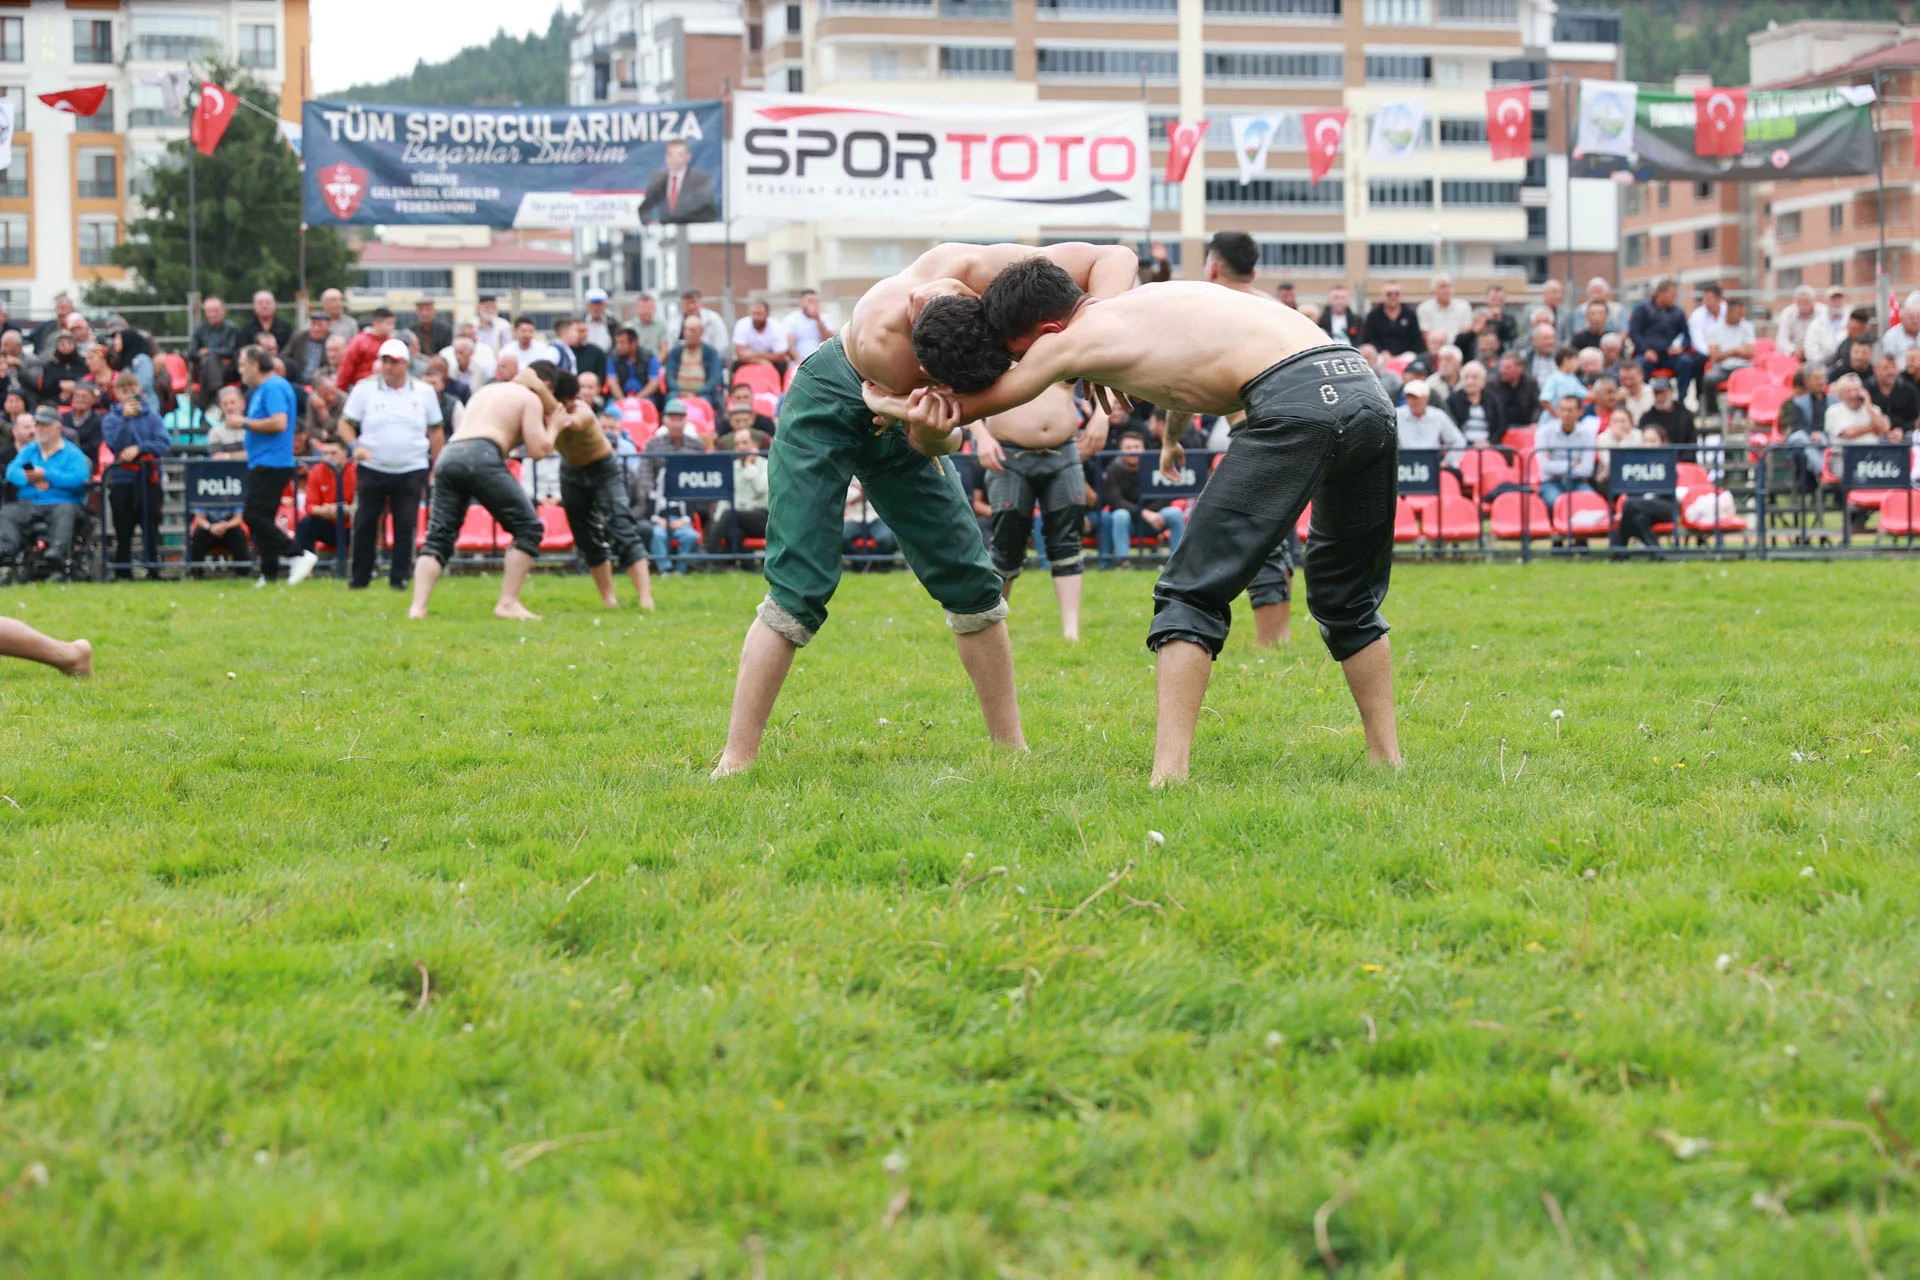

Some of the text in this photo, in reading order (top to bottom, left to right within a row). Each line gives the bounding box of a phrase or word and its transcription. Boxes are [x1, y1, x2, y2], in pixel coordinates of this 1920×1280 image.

[323, 105, 703, 143] TÜM SPORCULARIMIZA
[528, 137, 628, 165] Dilerim
[744, 128, 1136, 182] SPOR TOTO
